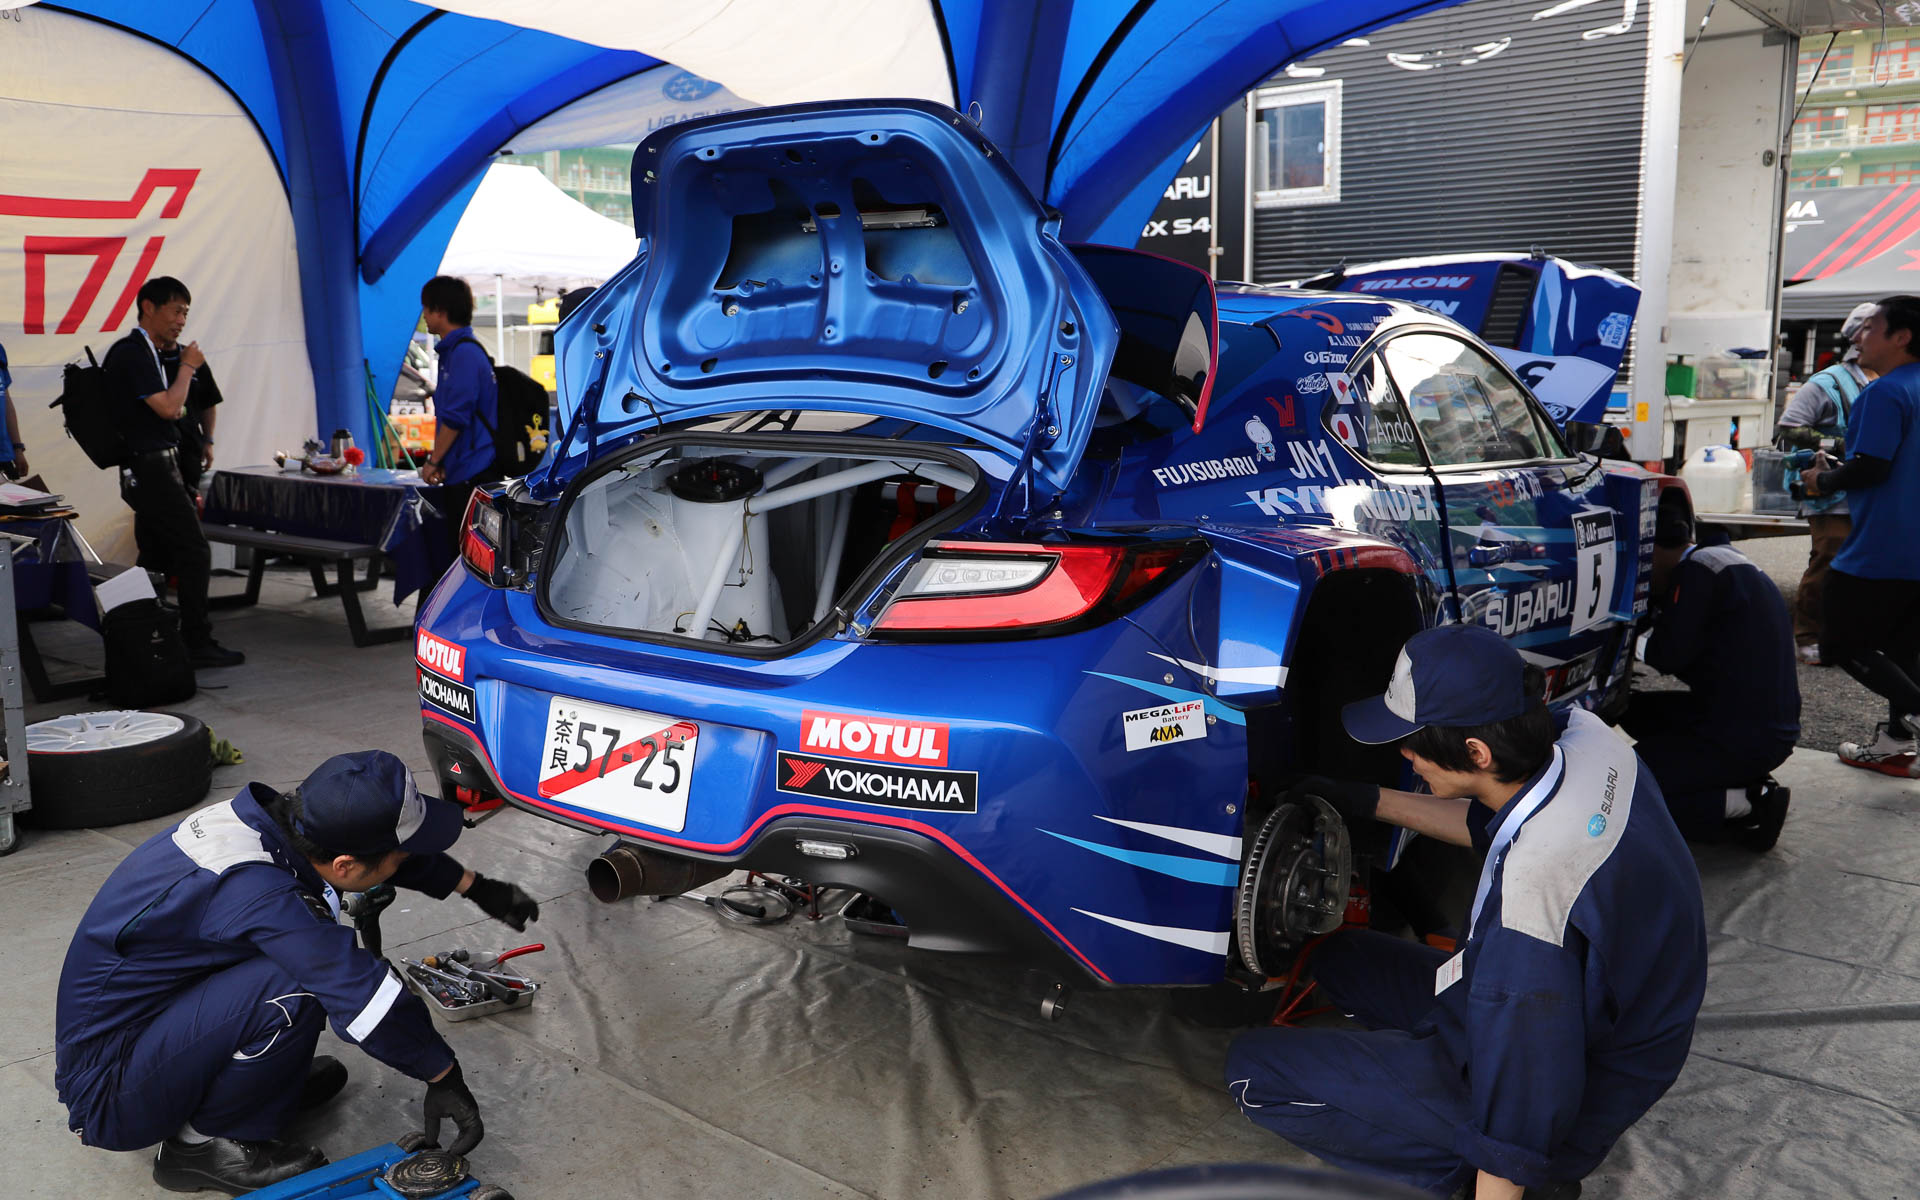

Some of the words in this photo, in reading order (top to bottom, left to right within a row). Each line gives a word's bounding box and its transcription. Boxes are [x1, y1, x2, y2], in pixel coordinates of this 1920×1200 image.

[1172, 216, 1212, 235] S4
[1360, 276, 1471, 291] MOTUL
[1152, 455, 1259, 487] FUJISUBARU
[1286, 438, 1345, 486] JN1
[1587, 552, 1603, 619] 5
[1485, 580, 1573, 637] SUBARU
[417, 633, 463, 677] MOTUL
[420, 673, 471, 714] YOKOHAMA
[805, 716, 941, 760] MOTUL
[1162, 714, 1190, 724] Battery
[549, 718, 574, 773] 奈良
[572, 721, 686, 794] 57-25
[824, 767, 965, 804] YOKOHAMA
[1600, 766, 1619, 816] SUBARU
